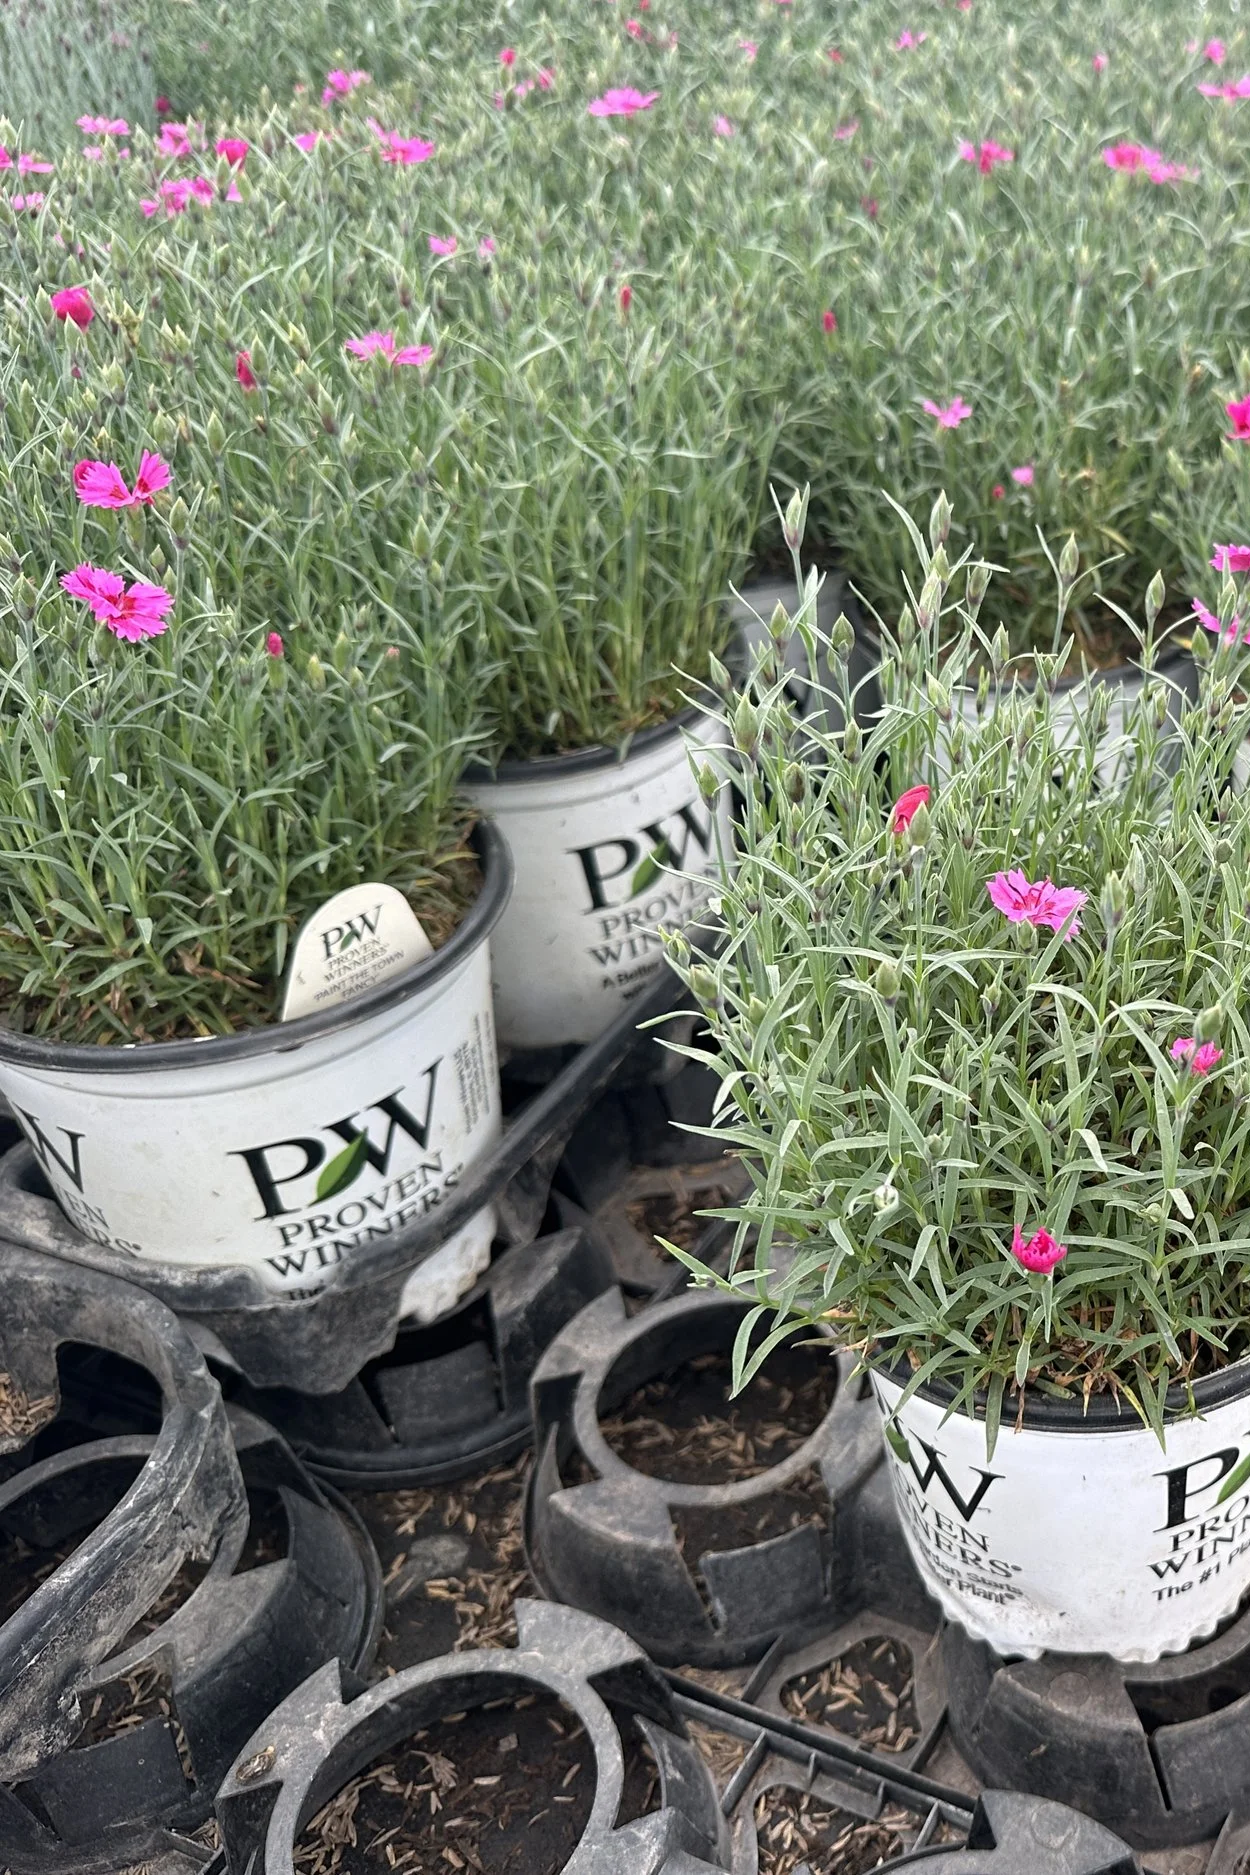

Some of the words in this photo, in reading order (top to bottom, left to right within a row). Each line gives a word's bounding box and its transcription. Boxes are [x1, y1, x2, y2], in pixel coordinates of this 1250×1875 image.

[319, 903, 384, 962] PW
[327, 936, 382, 971] PROVEN
[348, 968, 370, 985] THE
[370, 949, 406, 973] TOWN
[226, 1056, 445, 1223] PW
[277, 1150, 444, 1248] PROVEN
[966, 1571, 1024, 1597] Starts
[1151, 1580, 1194, 1602] The
[1199, 1561, 1222, 1584] #1
